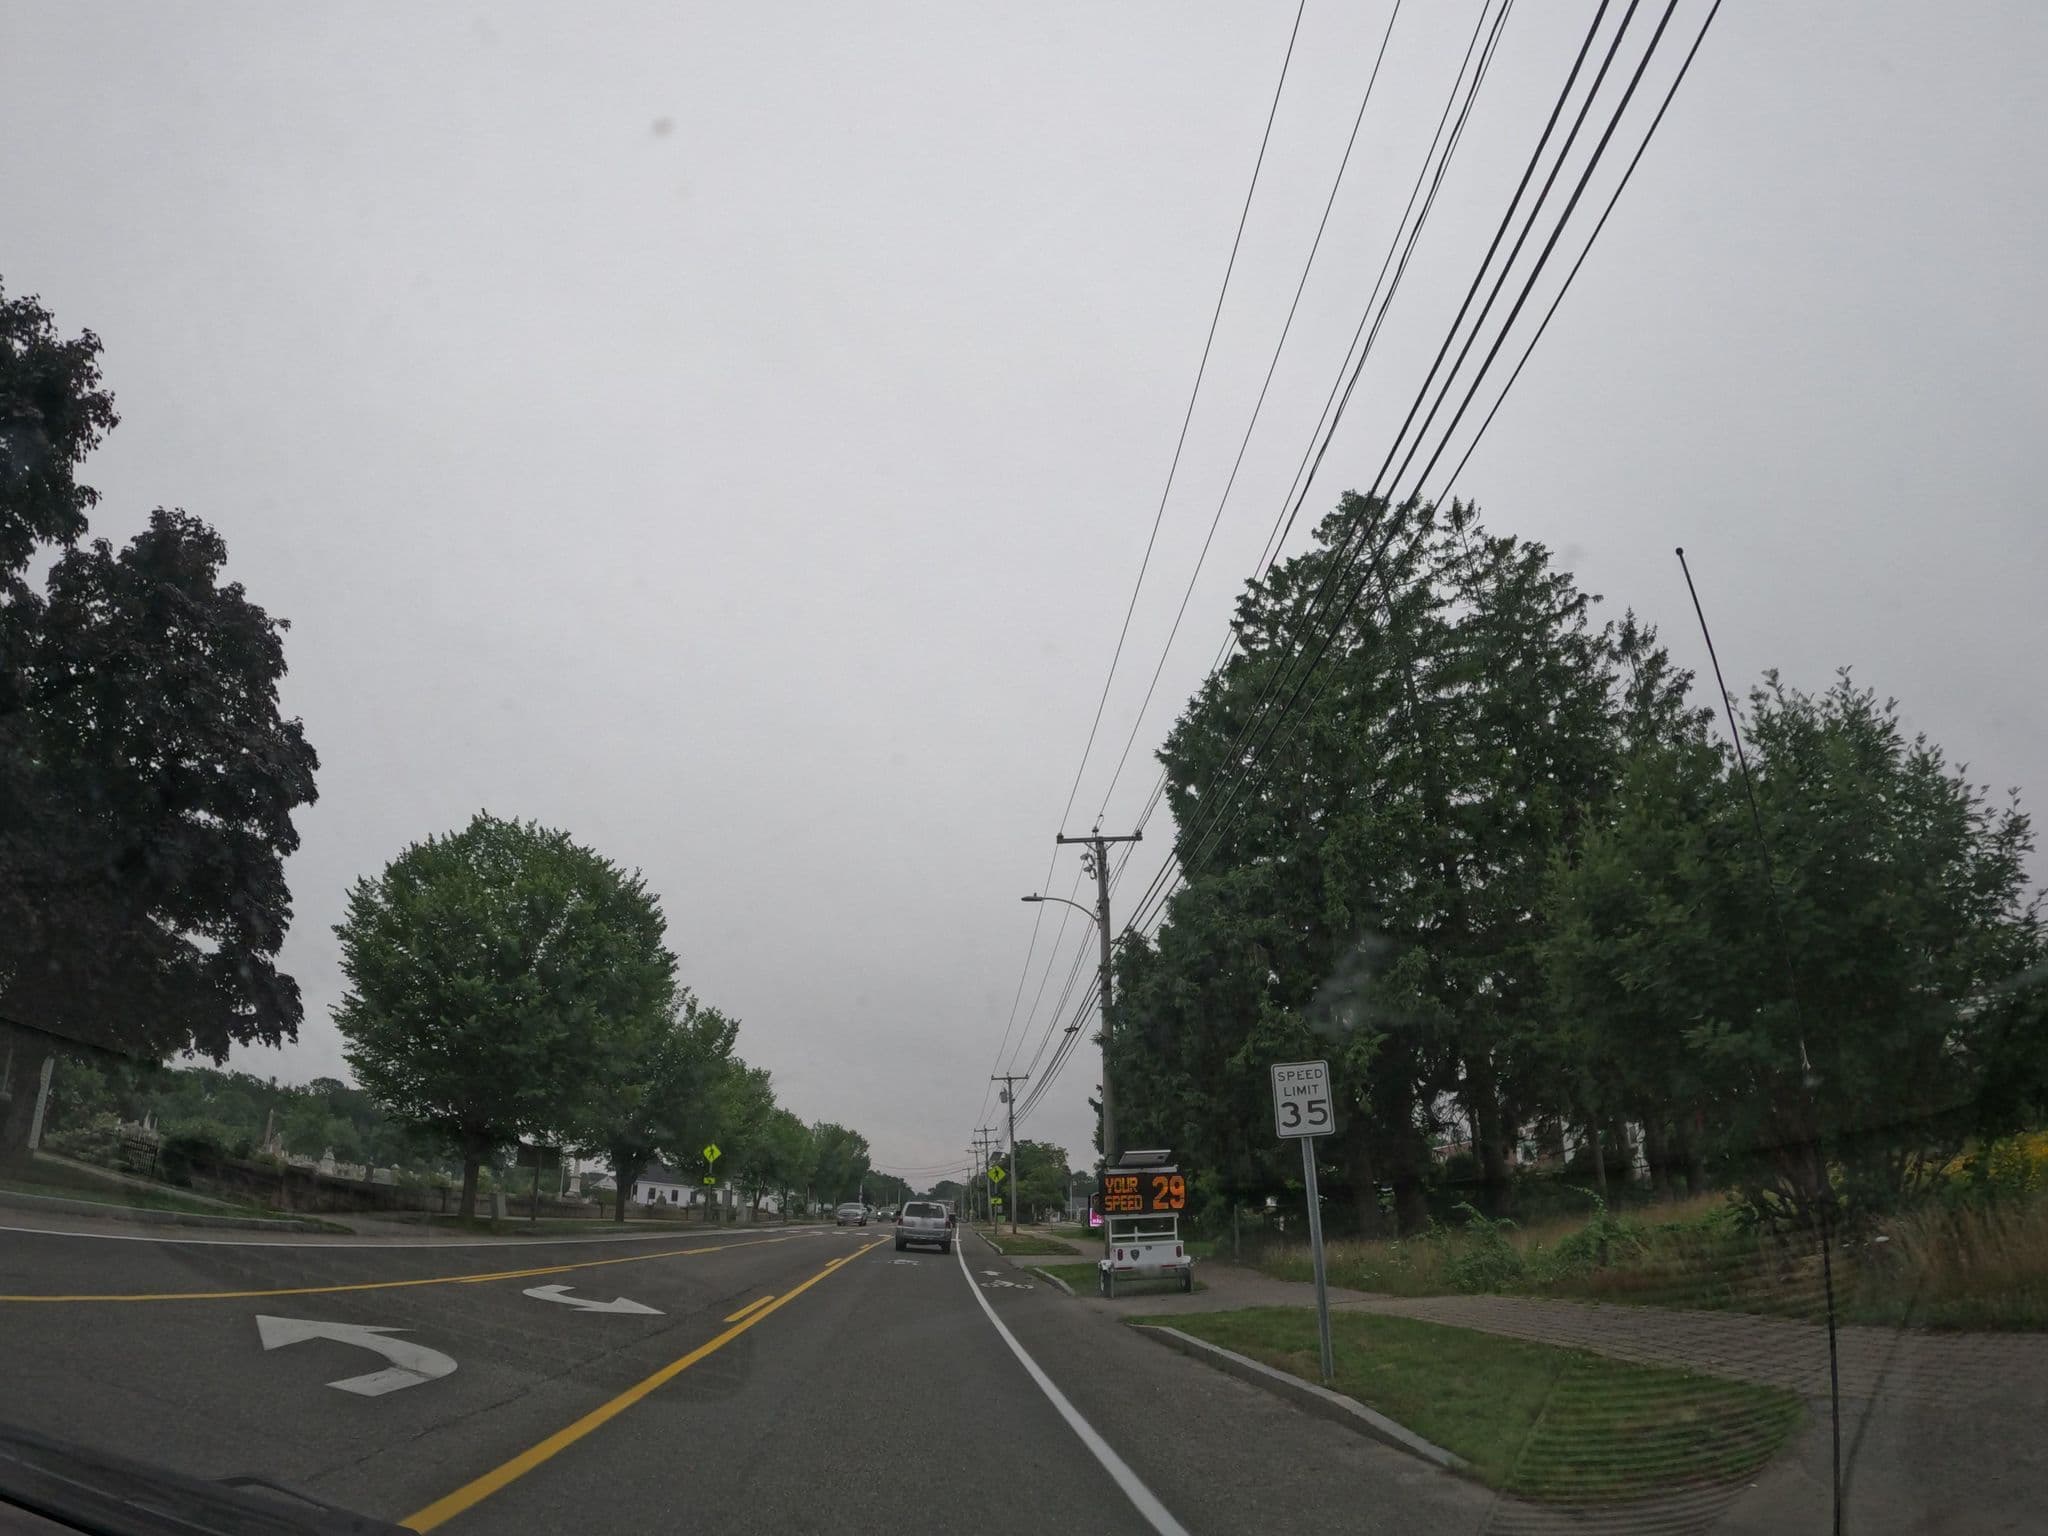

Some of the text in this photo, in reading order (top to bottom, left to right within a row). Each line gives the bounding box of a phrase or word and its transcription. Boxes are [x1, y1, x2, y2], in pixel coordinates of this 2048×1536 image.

[1278, 1069, 1323, 1082] SPEED
[1284, 1085, 1319, 1097] LIMIT
[1281, 1099, 1328, 1128] 35
[1105, 1176, 1138, 1193] YOUR
[1152, 1175, 1185, 1210] 29
[1105, 1195, 1143, 1211] SPEED
